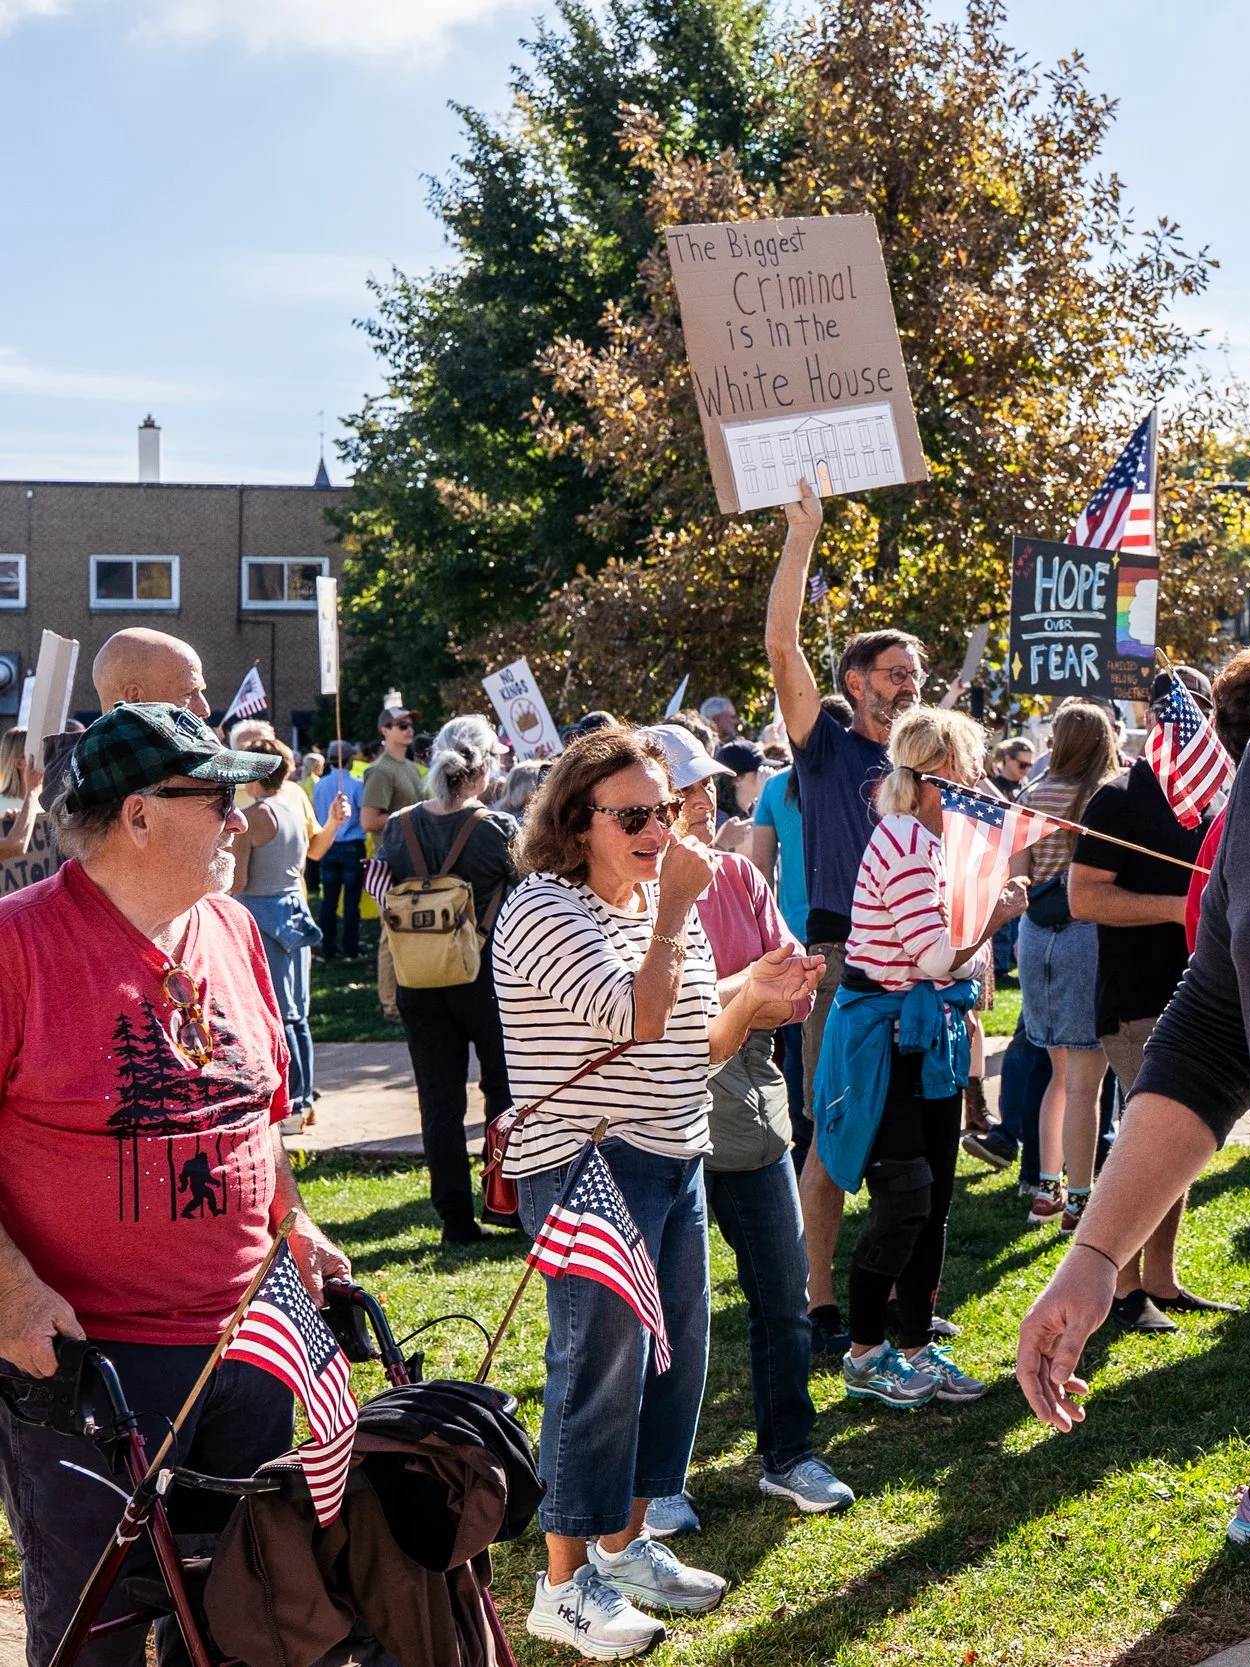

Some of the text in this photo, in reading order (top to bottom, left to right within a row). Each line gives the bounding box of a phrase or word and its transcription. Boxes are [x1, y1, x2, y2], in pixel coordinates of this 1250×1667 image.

[668, 226, 806, 268] The Biggest
[732, 265, 857, 315] Criminal
[725, 312, 840, 350] is in the
[694, 353, 893, 418] White House
[1034, 555, 1111, 613] HOPE
[1043, 618, 1074, 632] OVER
[498, 668, 515, 685] NO
[1030, 642, 1101, 687] FEAR
[499, 679, 529, 702] KINGS
[557, 1603, 592, 1634] HOKA
